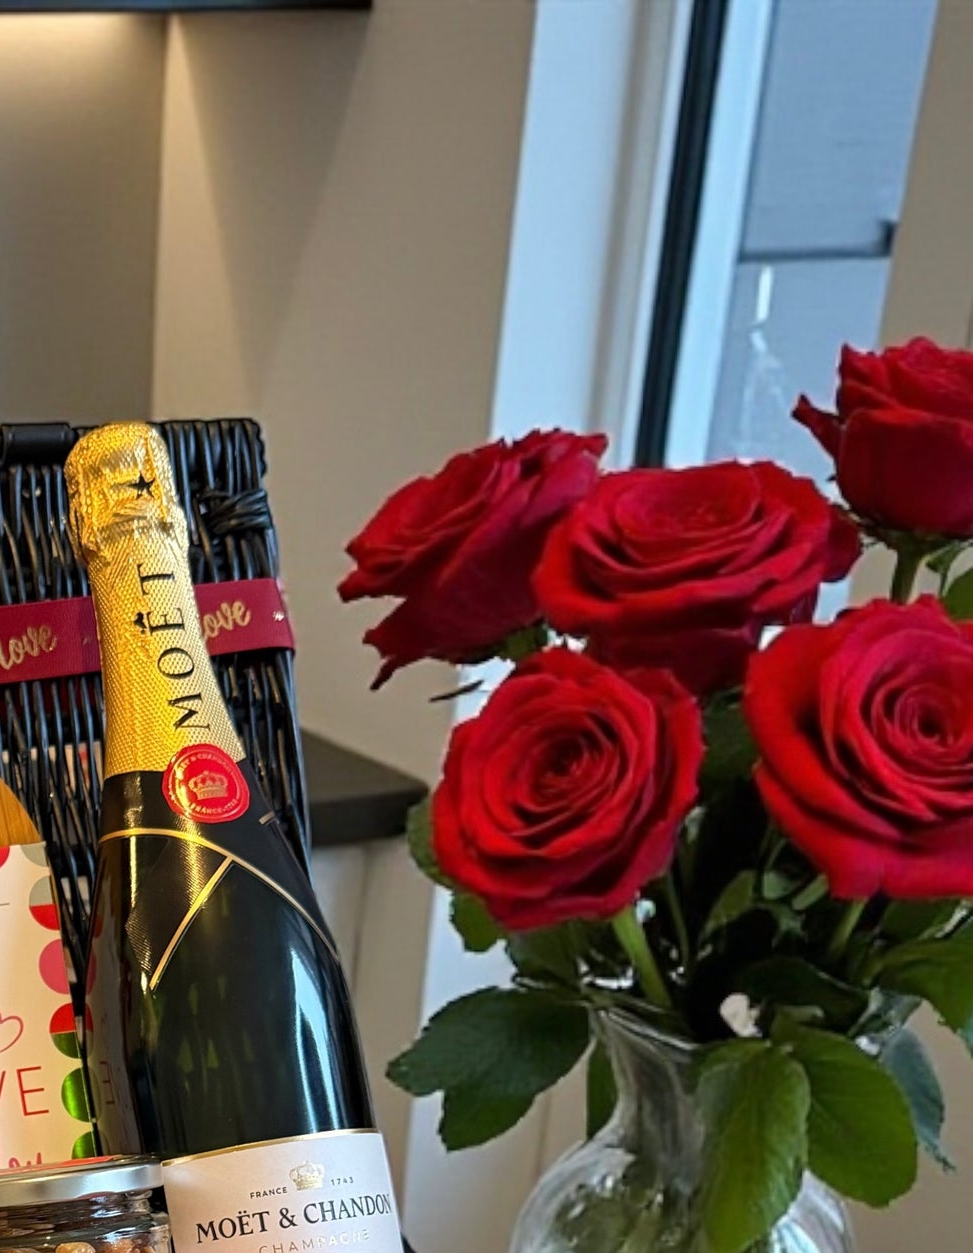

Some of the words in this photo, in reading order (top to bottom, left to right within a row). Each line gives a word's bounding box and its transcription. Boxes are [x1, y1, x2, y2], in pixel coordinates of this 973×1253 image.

[202, 600, 252, 642] ove
[250, 1186, 287, 1199] FRANCE
[330, 1176, 354, 1186] 1743
[196, 1209, 270, 1244] MOËT
[279, 1207, 298, 1229] &
[303, 1193, 393, 1225] CHANDON
